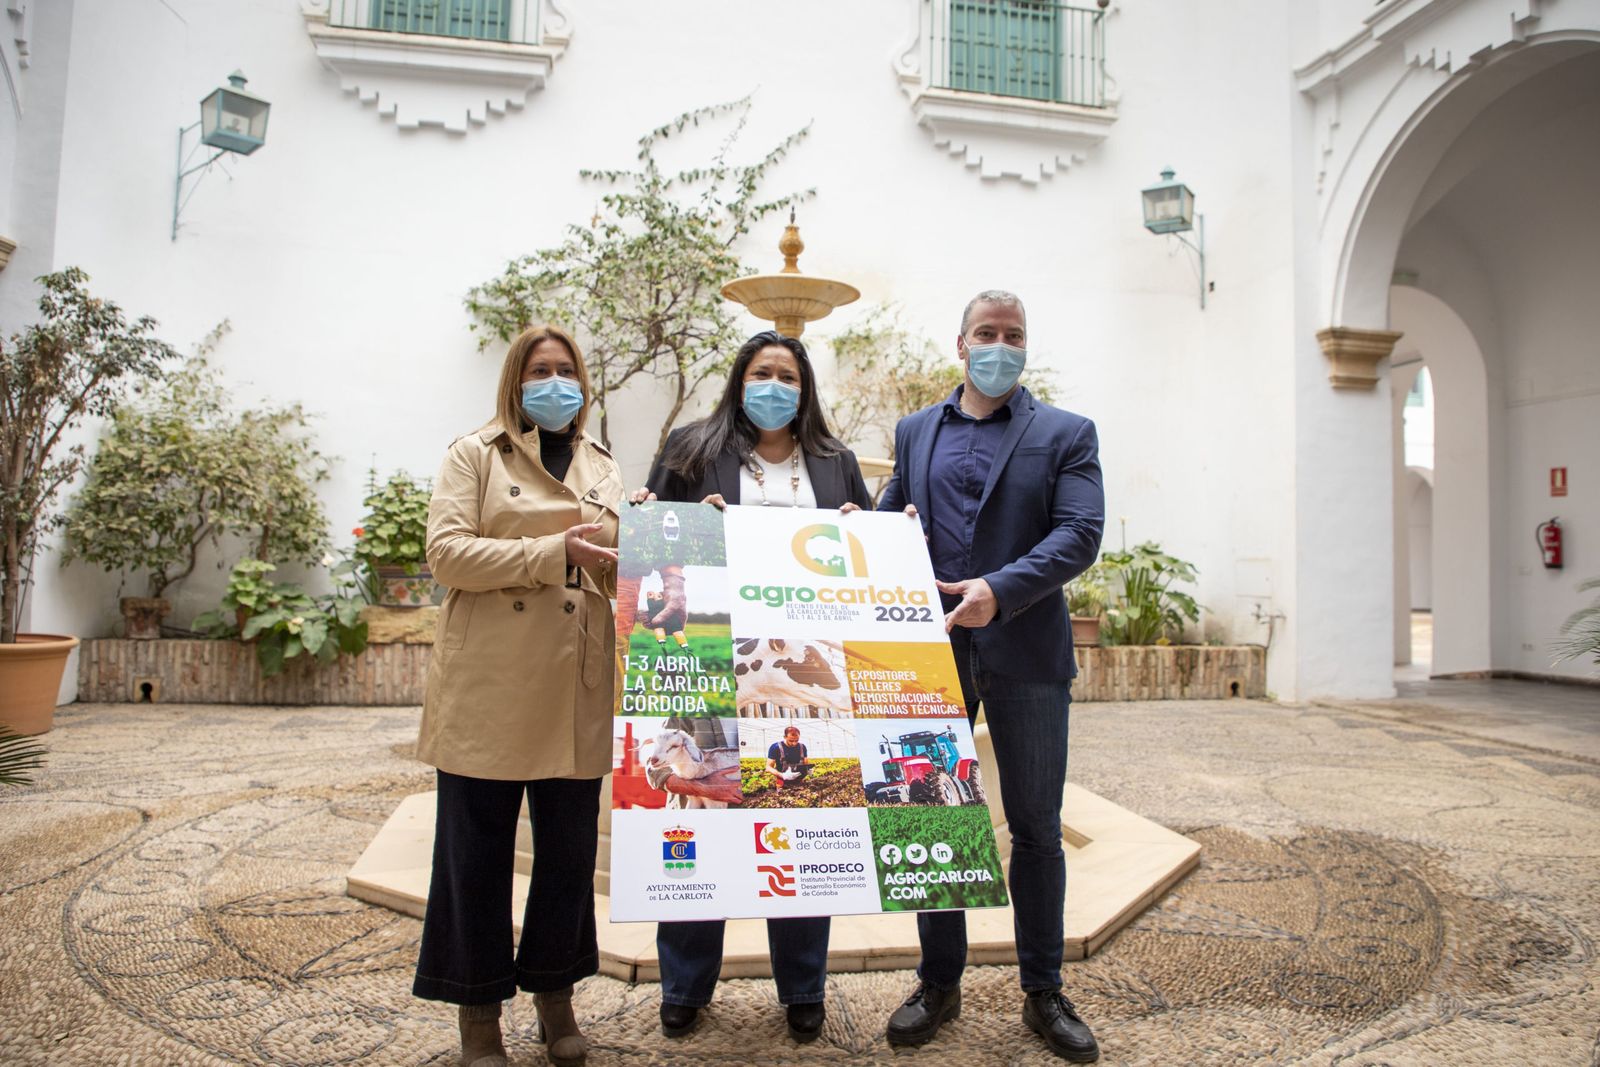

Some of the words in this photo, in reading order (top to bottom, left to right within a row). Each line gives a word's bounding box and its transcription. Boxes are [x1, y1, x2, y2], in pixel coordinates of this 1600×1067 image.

[739, 584, 930, 608] agrocarlota
[874, 606, 934, 622] 2022
[622, 655, 649, 671] 1-3
[654, 656, 706, 672] ABRIL
[850, 670, 917, 680] EXPOSITORES
[623, 674, 646, 691] LA
[652, 675, 731, 692] CARLOTA
[852, 681, 902, 692] TALLERES
[622, 690, 708, 713] CÓRDOBA
[854, 692, 943, 703] DEMOSTRACIONES
[856, 704, 908, 715] JORNADAS
[910, 702, 960, 715] TÉCNICAS
[795, 828, 859, 840] Diputación
[796, 841, 810, 850] de
[814, 840, 861, 850] Córdoba
[799, 863, 865, 874] IPRODECO
[884, 869, 994, 886] AGROCARLOTA
[646, 883, 716, 892] AYUNTAMIENTO
[886, 886, 928, 900] .COM
